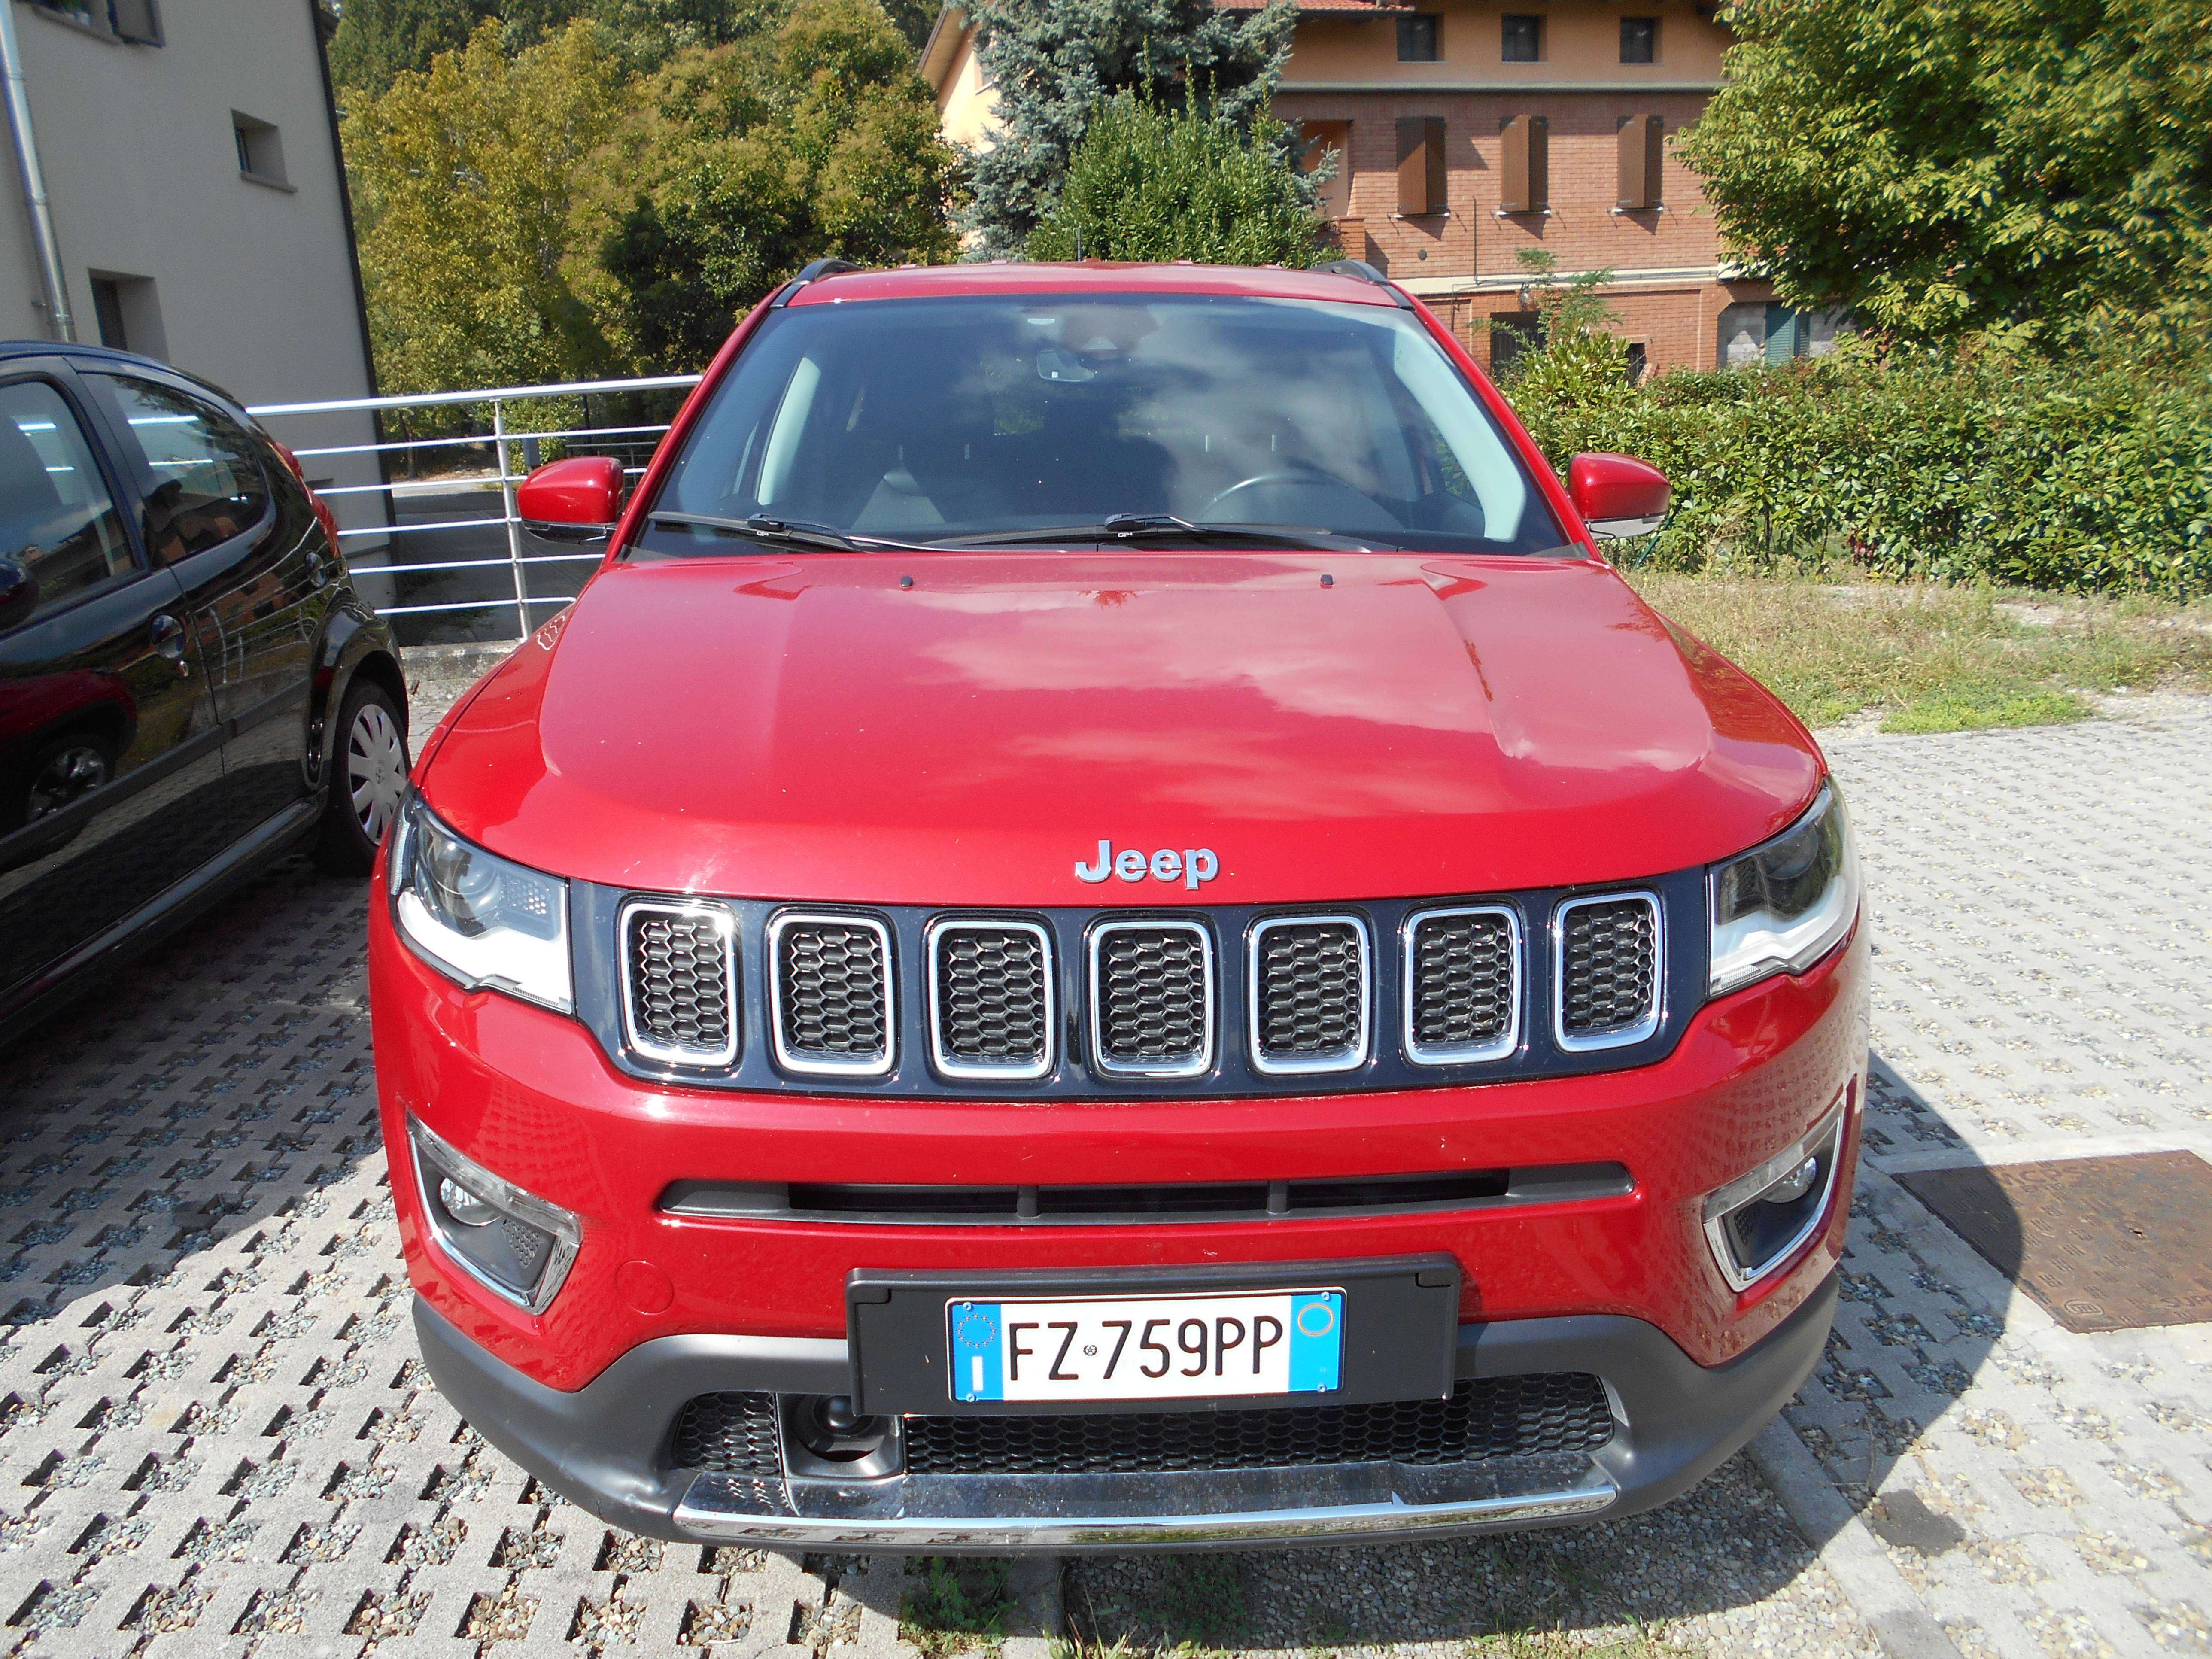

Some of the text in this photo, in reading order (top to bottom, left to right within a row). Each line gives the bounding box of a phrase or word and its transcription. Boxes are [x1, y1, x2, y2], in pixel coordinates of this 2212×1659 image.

[1075, 839, 1219, 890] Jeep
[1009, 1315, 1283, 1381] FZ 759PP
